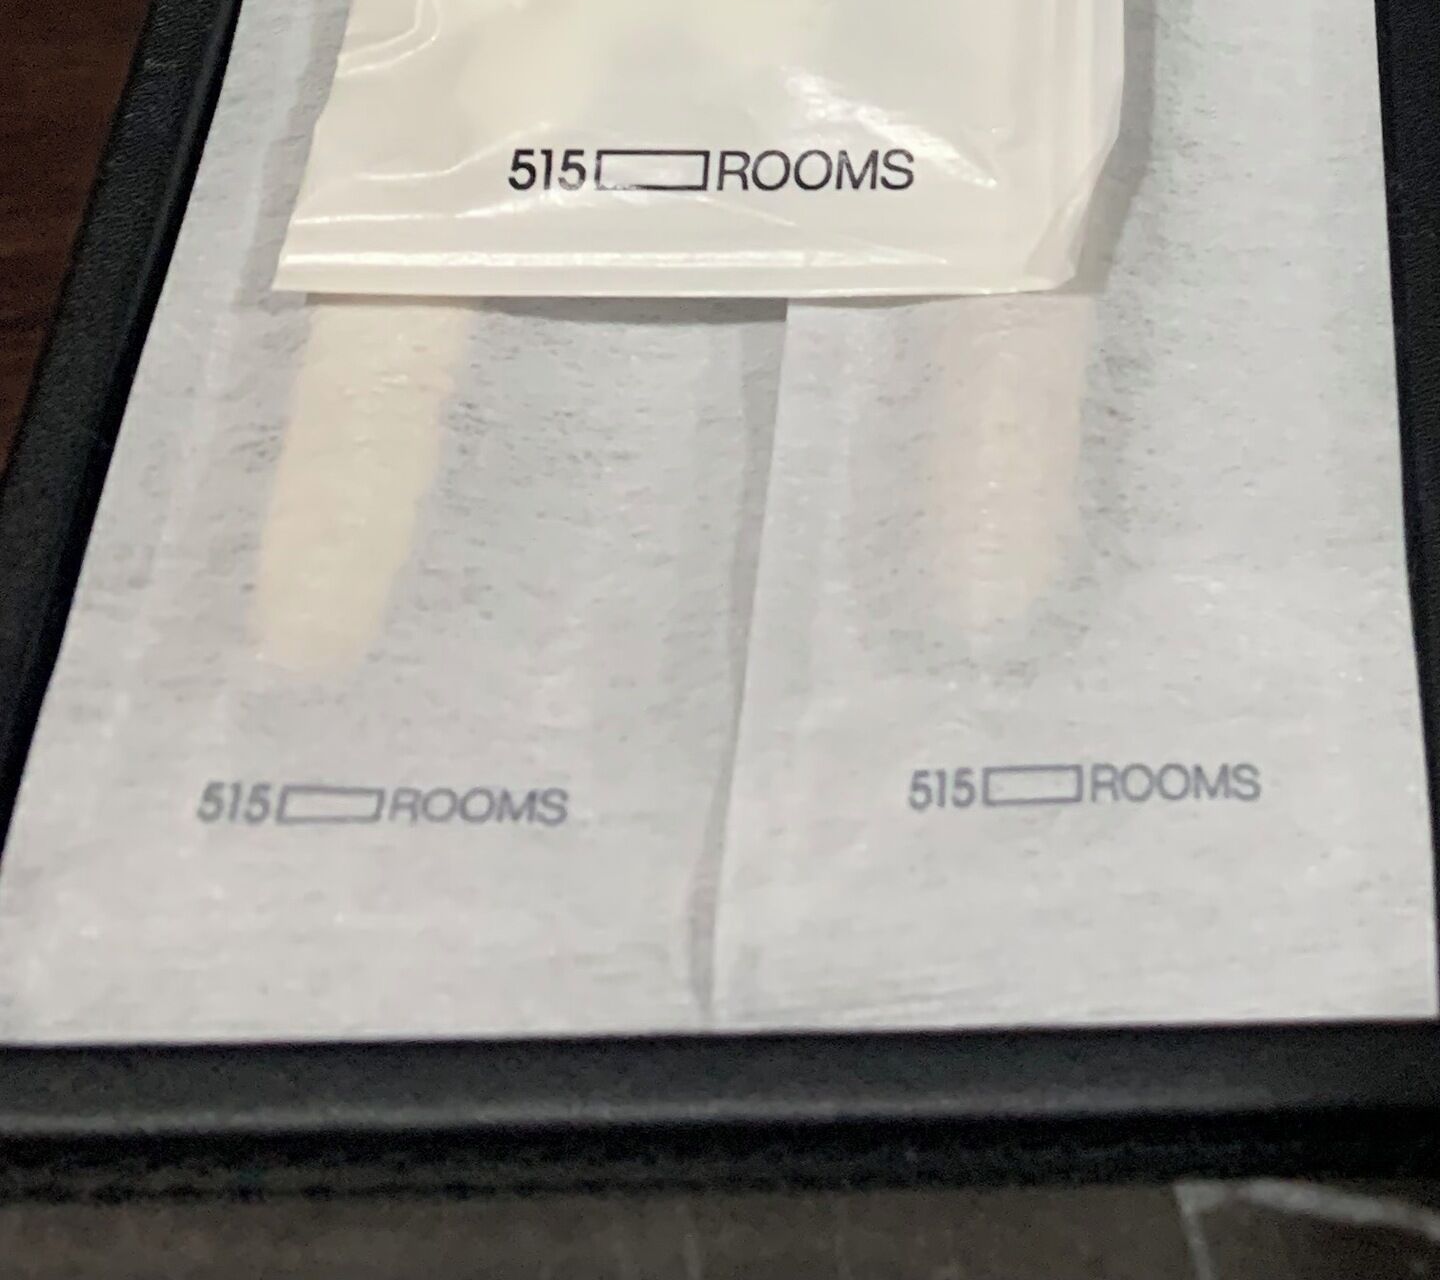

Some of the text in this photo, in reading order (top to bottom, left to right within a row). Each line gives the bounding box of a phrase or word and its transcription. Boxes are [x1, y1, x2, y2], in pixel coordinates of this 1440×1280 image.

[507, 148, 916, 192] 515 ROOMS
[197, 781, 570, 827] 515 ROOMS
[908, 762, 1262, 811] 515 ROOMS
